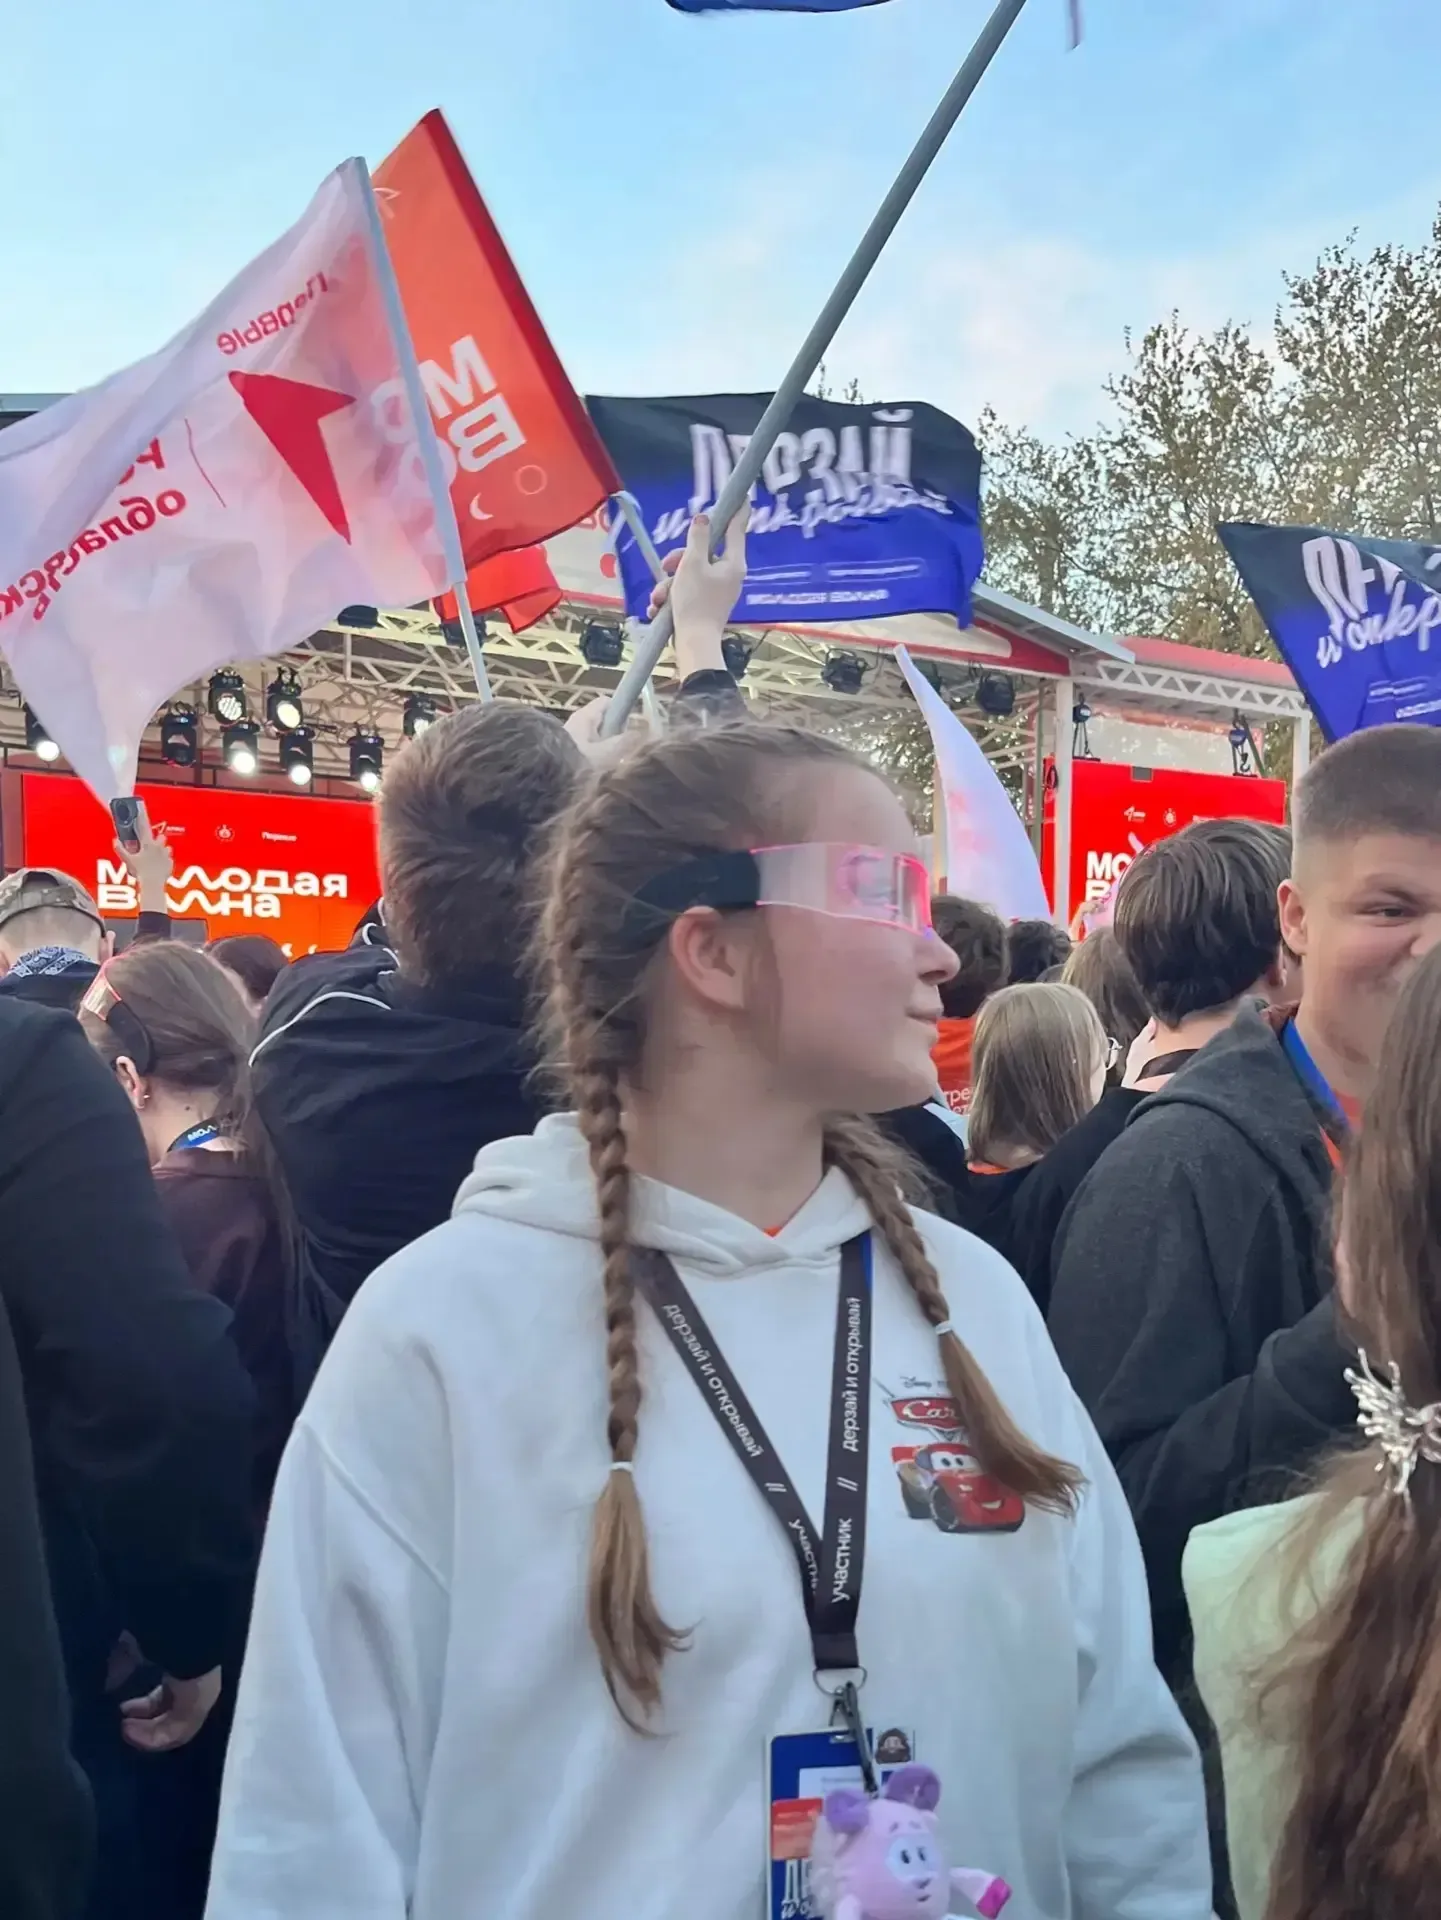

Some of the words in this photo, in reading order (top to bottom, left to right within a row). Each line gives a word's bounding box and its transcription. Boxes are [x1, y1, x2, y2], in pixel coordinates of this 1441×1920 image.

[700, 1362, 717, 1377] и
[846, 1376, 859, 1389] и
[842, 1389, 861, 1452] дерзай
[831, 1518, 852, 1604] участник
